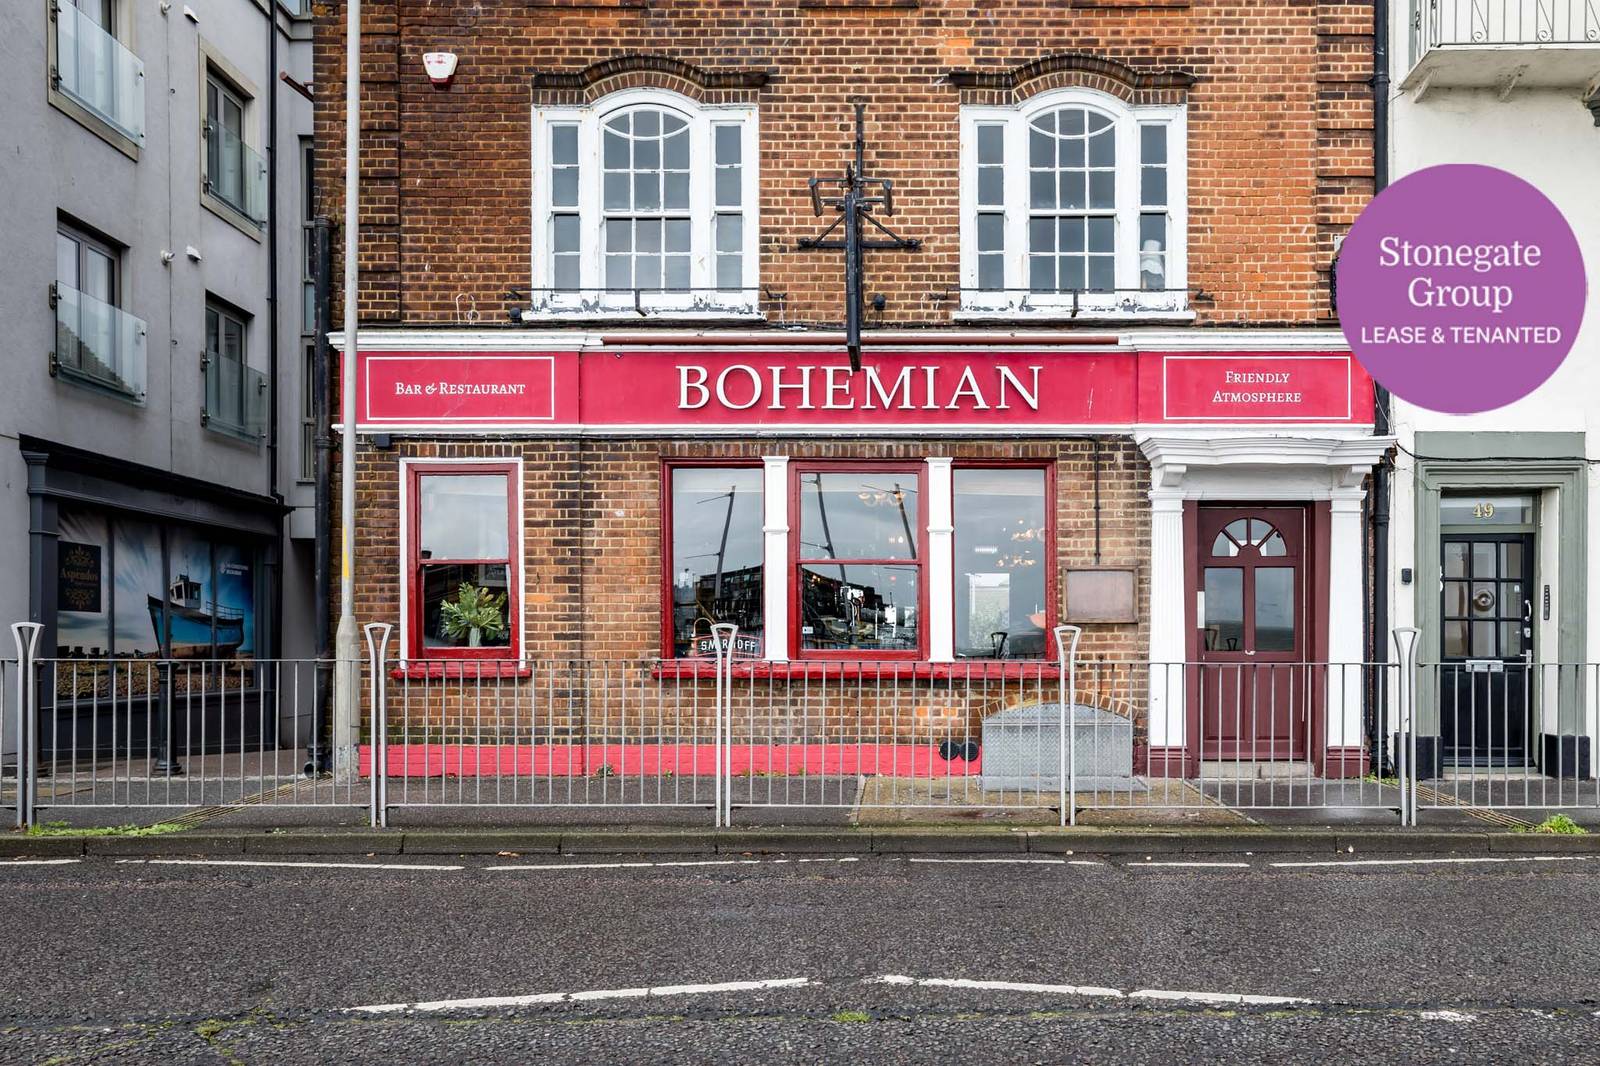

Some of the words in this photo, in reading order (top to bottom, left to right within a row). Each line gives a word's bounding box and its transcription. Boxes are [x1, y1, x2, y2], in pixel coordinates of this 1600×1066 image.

[425, 383, 438, 395] &
[675, 364, 1044, 411] BOHEMIAN
[1472, 502, 1495, 518] 49
[700, 638, 756, 652] SMROFF
